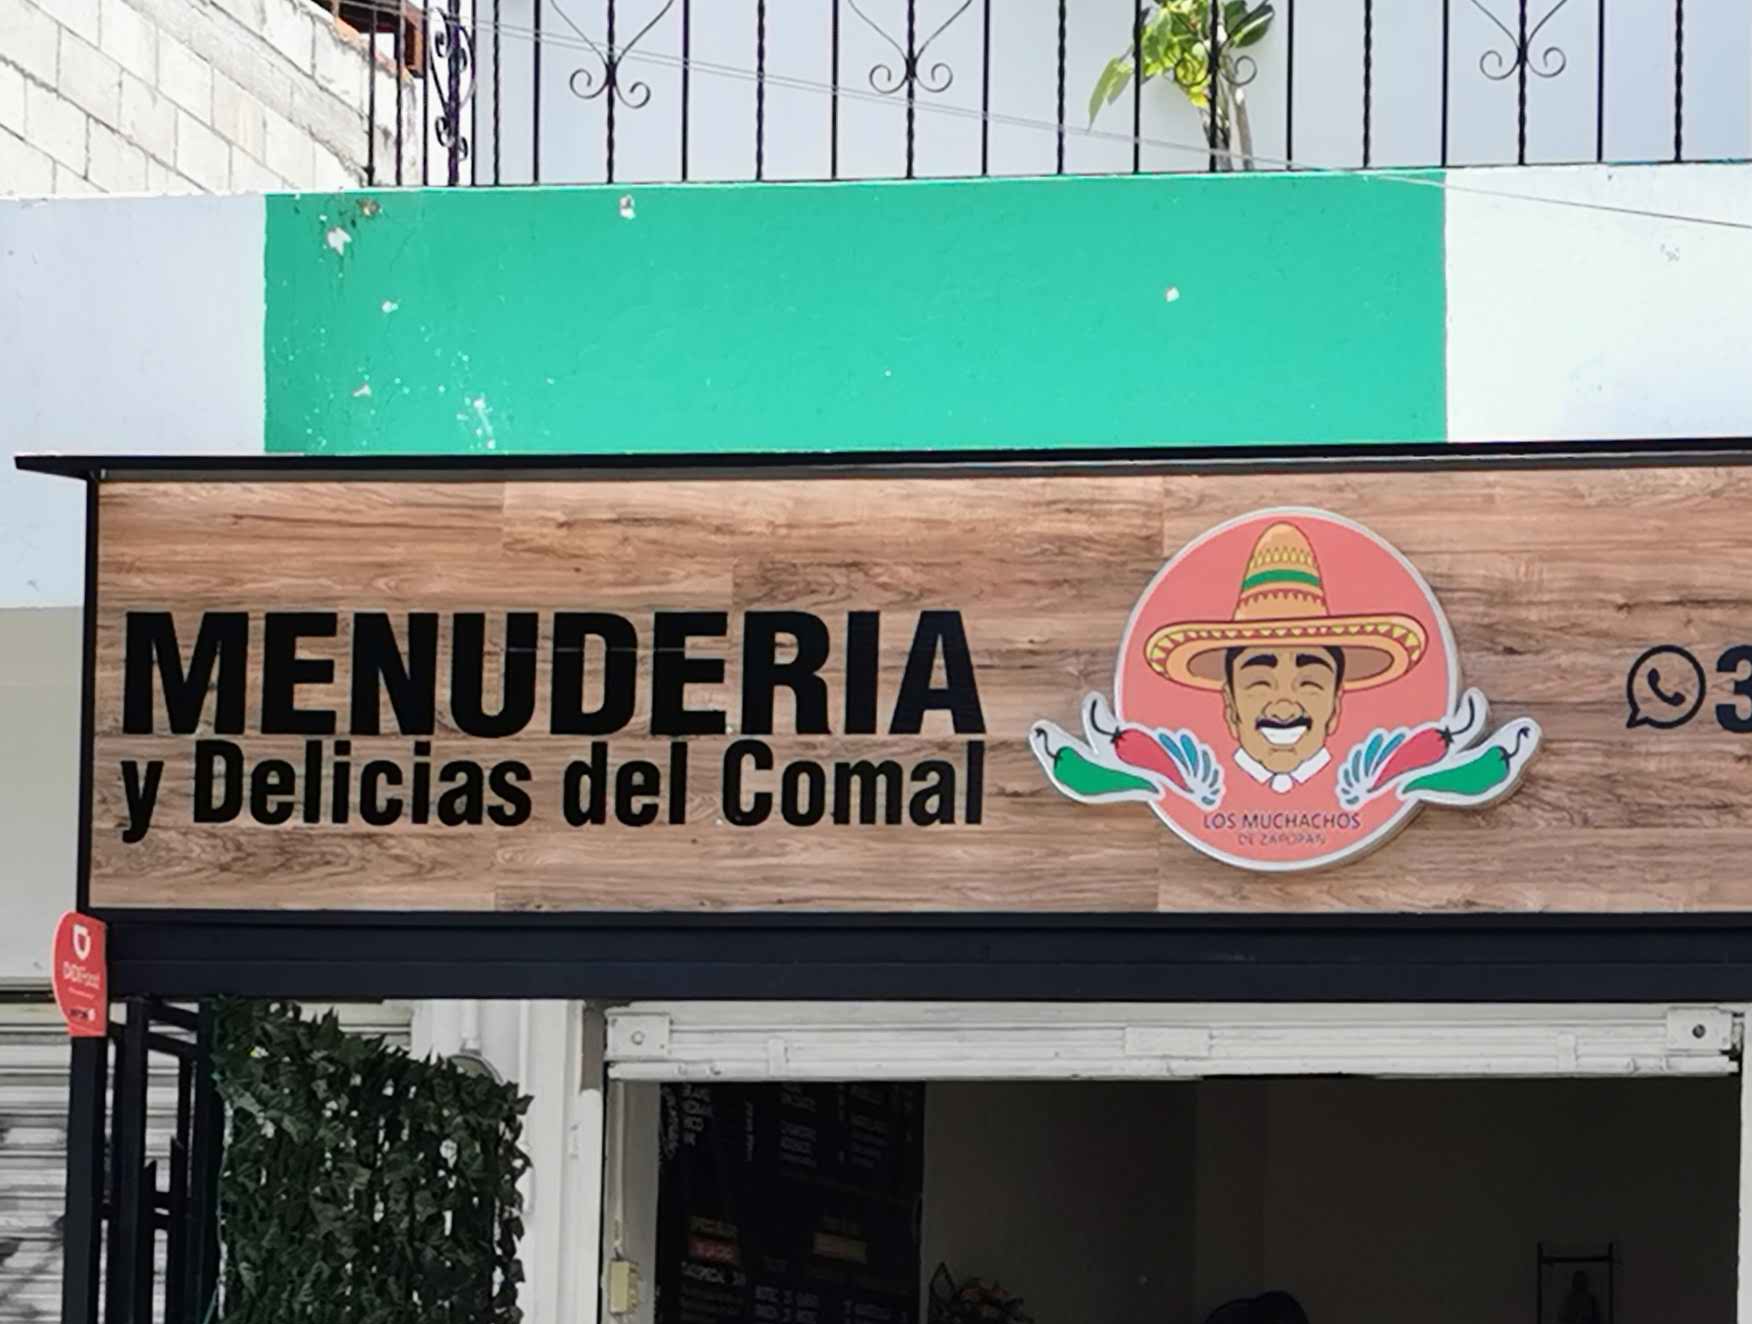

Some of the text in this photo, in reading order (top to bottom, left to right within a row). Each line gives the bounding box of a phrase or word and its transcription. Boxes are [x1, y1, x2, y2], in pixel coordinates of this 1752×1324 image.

[121, 610, 985, 737] MENUDERIA
[120, 739, 984, 842] y Delicias del Comal
[1203, 811, 1361, 829] LOS MUCHACHOS
[1238, 833, 1328, 846] DE ZAPOPAN
